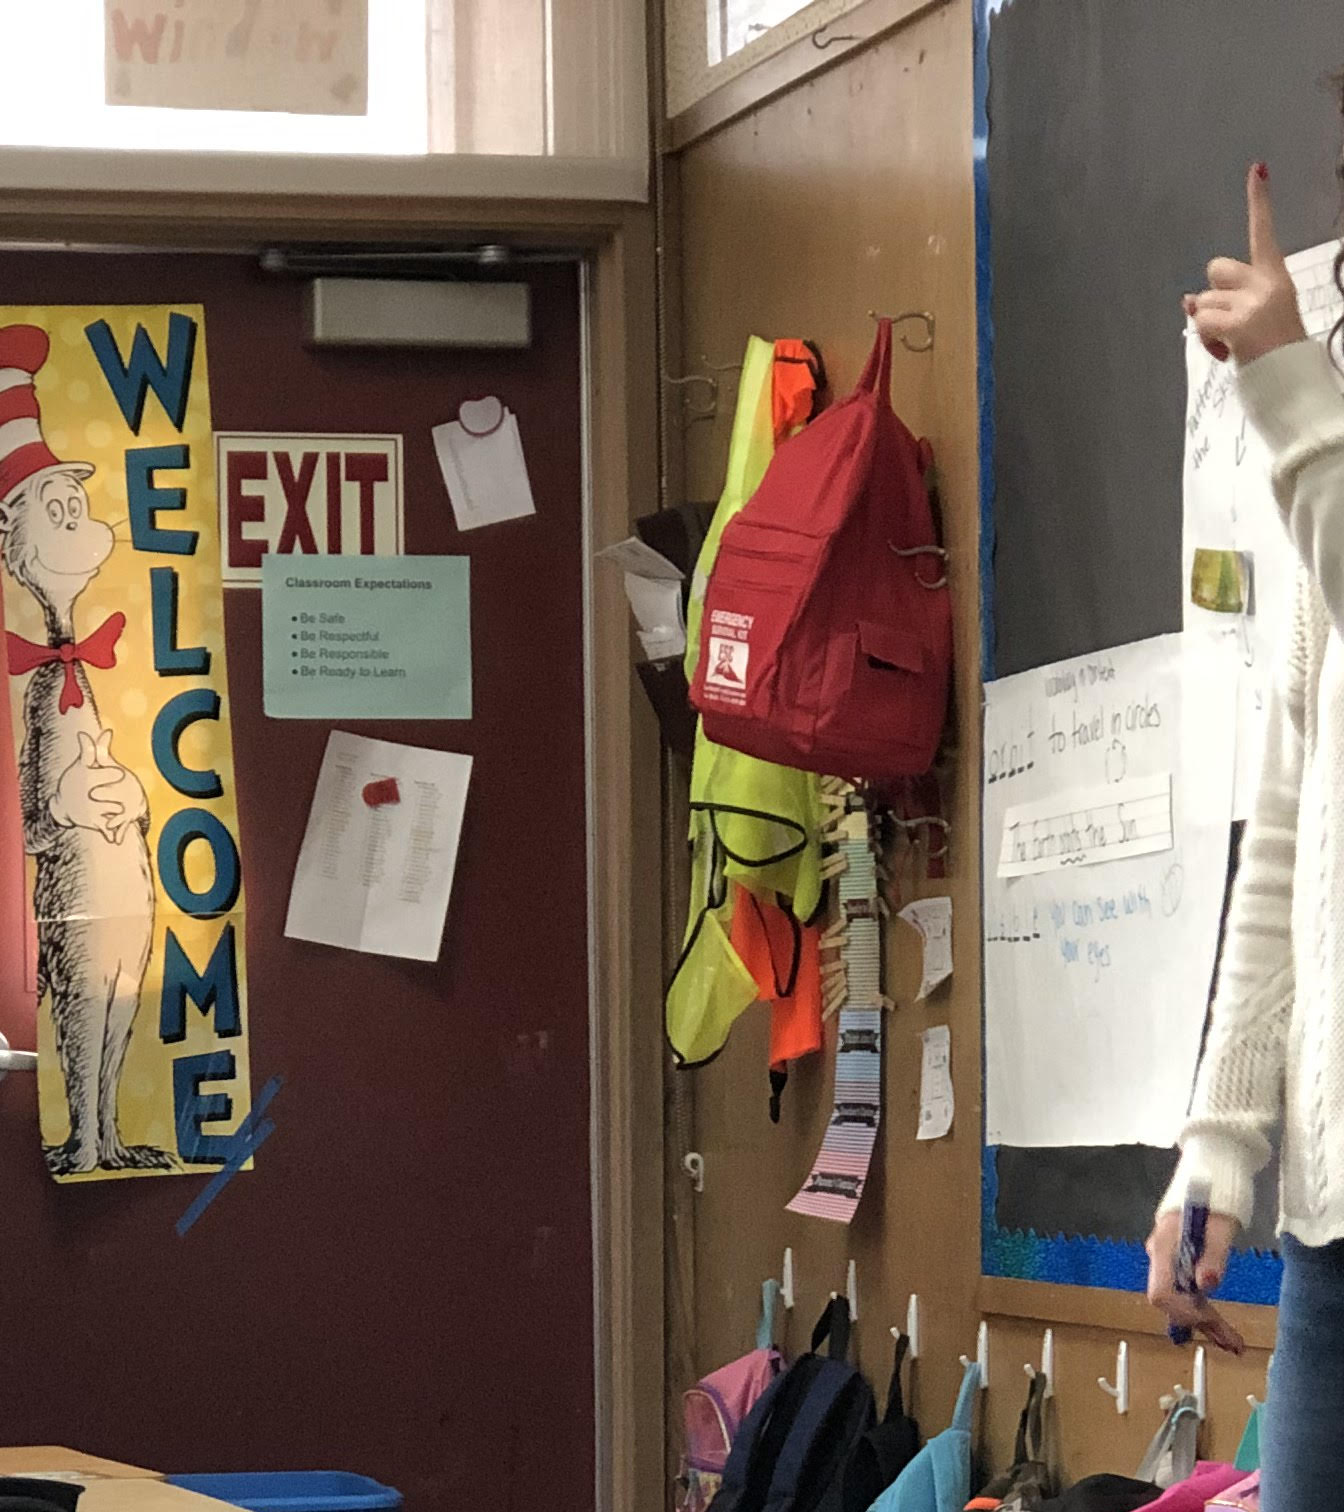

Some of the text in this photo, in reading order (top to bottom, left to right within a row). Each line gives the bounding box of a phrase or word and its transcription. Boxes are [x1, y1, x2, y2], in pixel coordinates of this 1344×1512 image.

[227, 451, 389, 568] EXIT
[285, 577, 432, 591] Classroom Expectations
[300, 612, 345, 624] Be Safe
[300, 630, 379, 643] Be Respectful
[300, 647, 390, 662] Be Responsible
[300, 665, 316, 678] Be
[319, 665, 356, 679] Ready
[373, 666, 406, 678] Learn
[84, 312, 244, 1166] WELCOME
